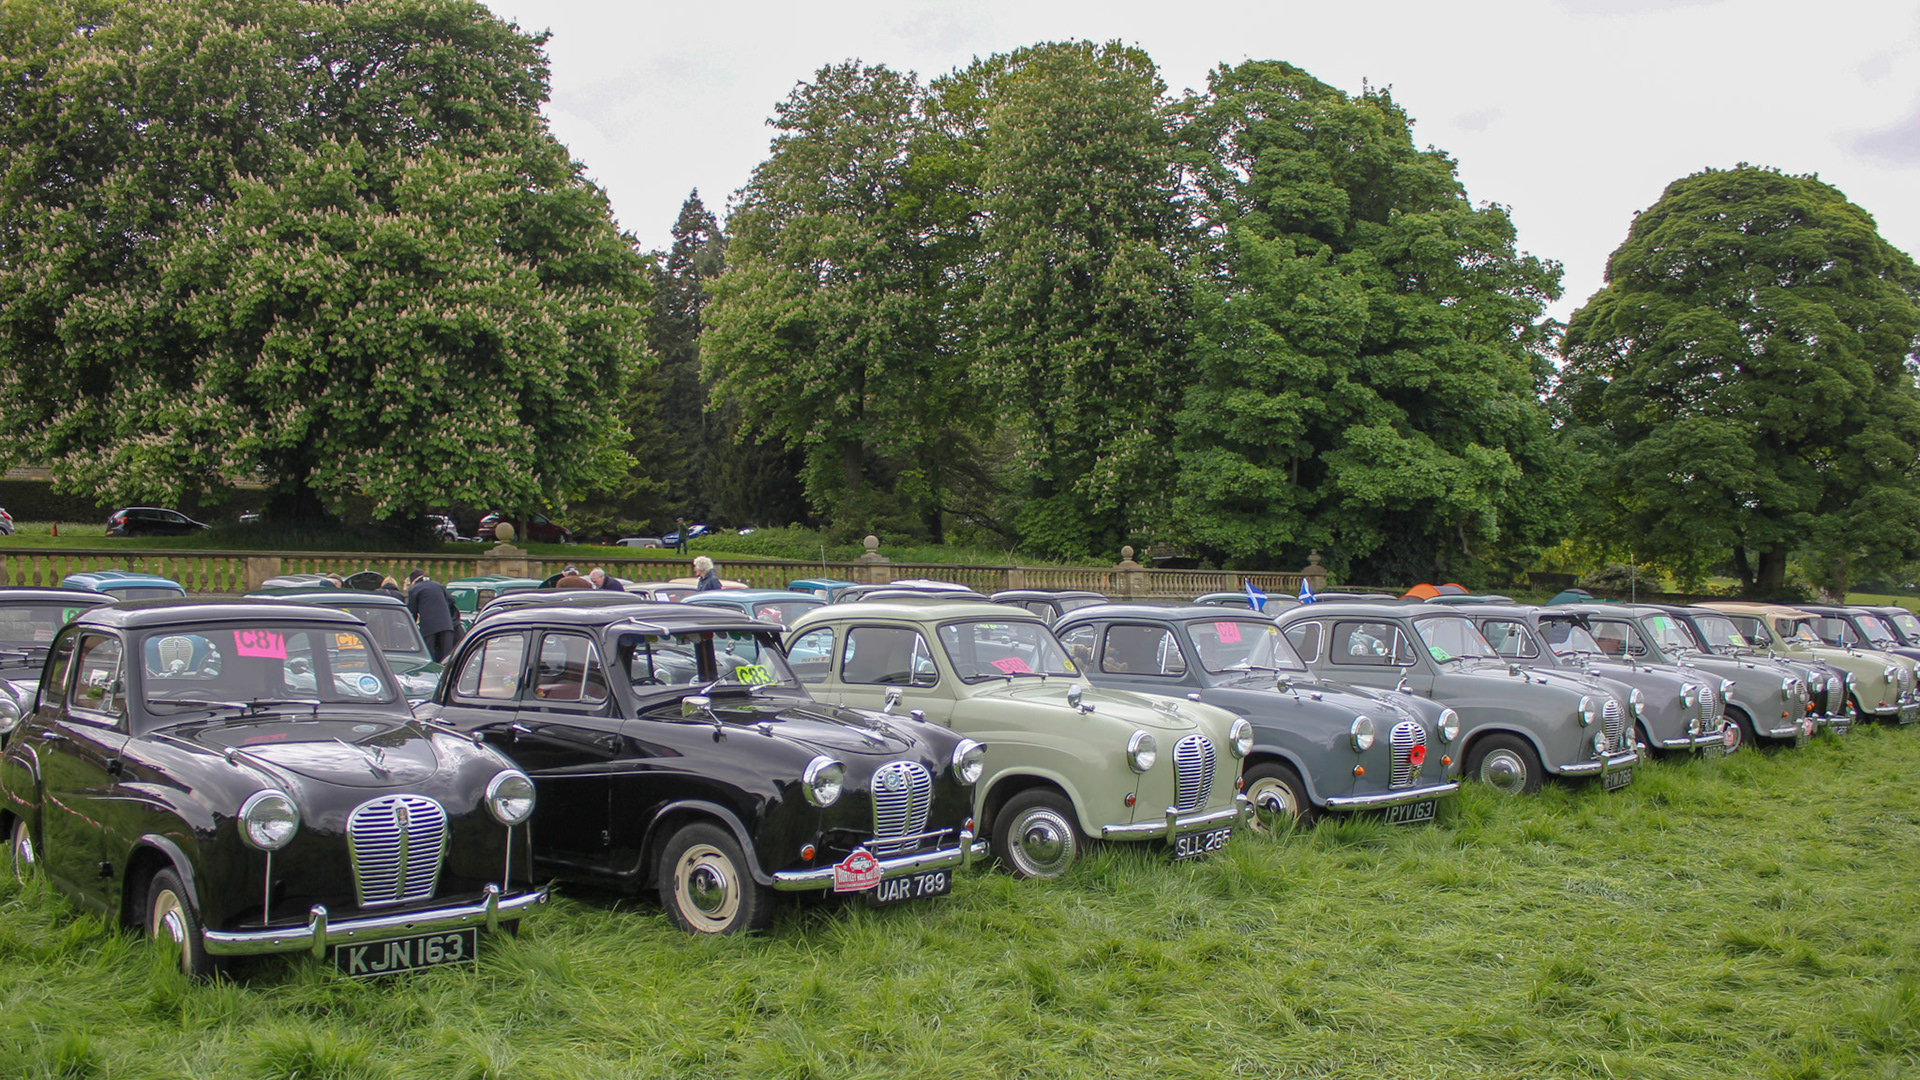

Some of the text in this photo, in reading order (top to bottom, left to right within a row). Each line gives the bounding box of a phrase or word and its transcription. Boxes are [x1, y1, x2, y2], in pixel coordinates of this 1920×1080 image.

[239, 629, 281, 650] C87
[740, 667, 772, 685] C83
[877, 873, 945, 901] UAR 789
